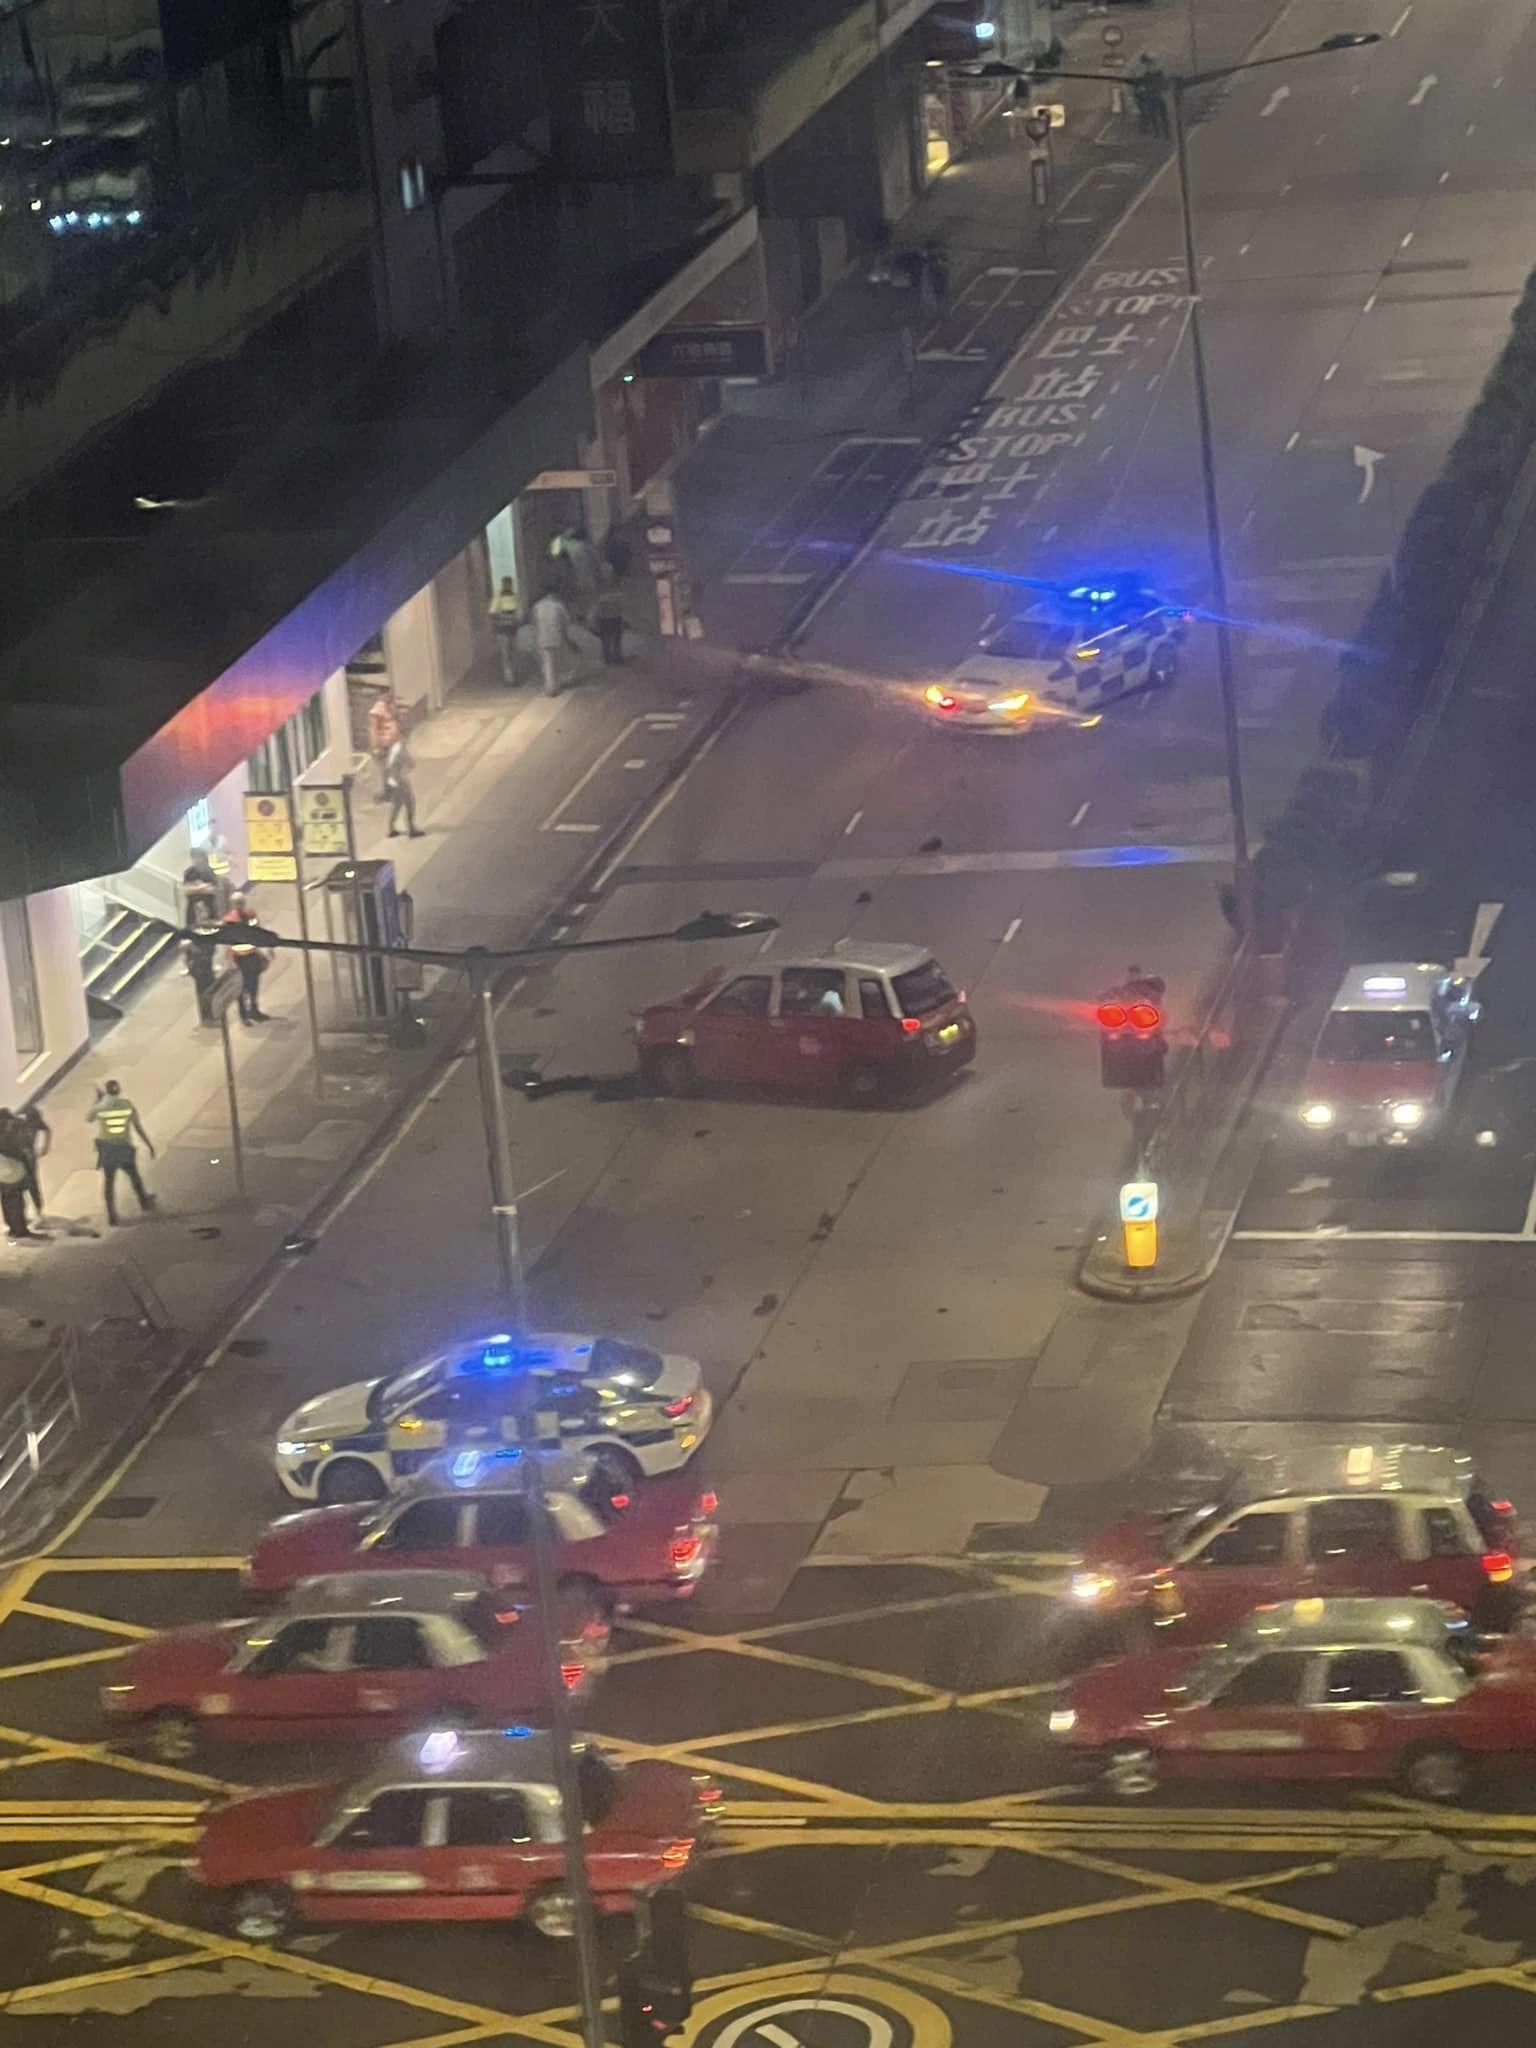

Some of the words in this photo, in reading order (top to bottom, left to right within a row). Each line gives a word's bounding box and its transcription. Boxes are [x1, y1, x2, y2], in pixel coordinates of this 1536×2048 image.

[1092, 267, 1186, 290] BUS
[1037, 323, 1138, 358] 巴士
[1014, 364, 1103, 402] 站
[983, 403, 1088, 429] BUS
[946, 433, 1073, 461] STOP
[905, 461, 1039, 501] 巴士
[901, 505, 1000, 548] 站
